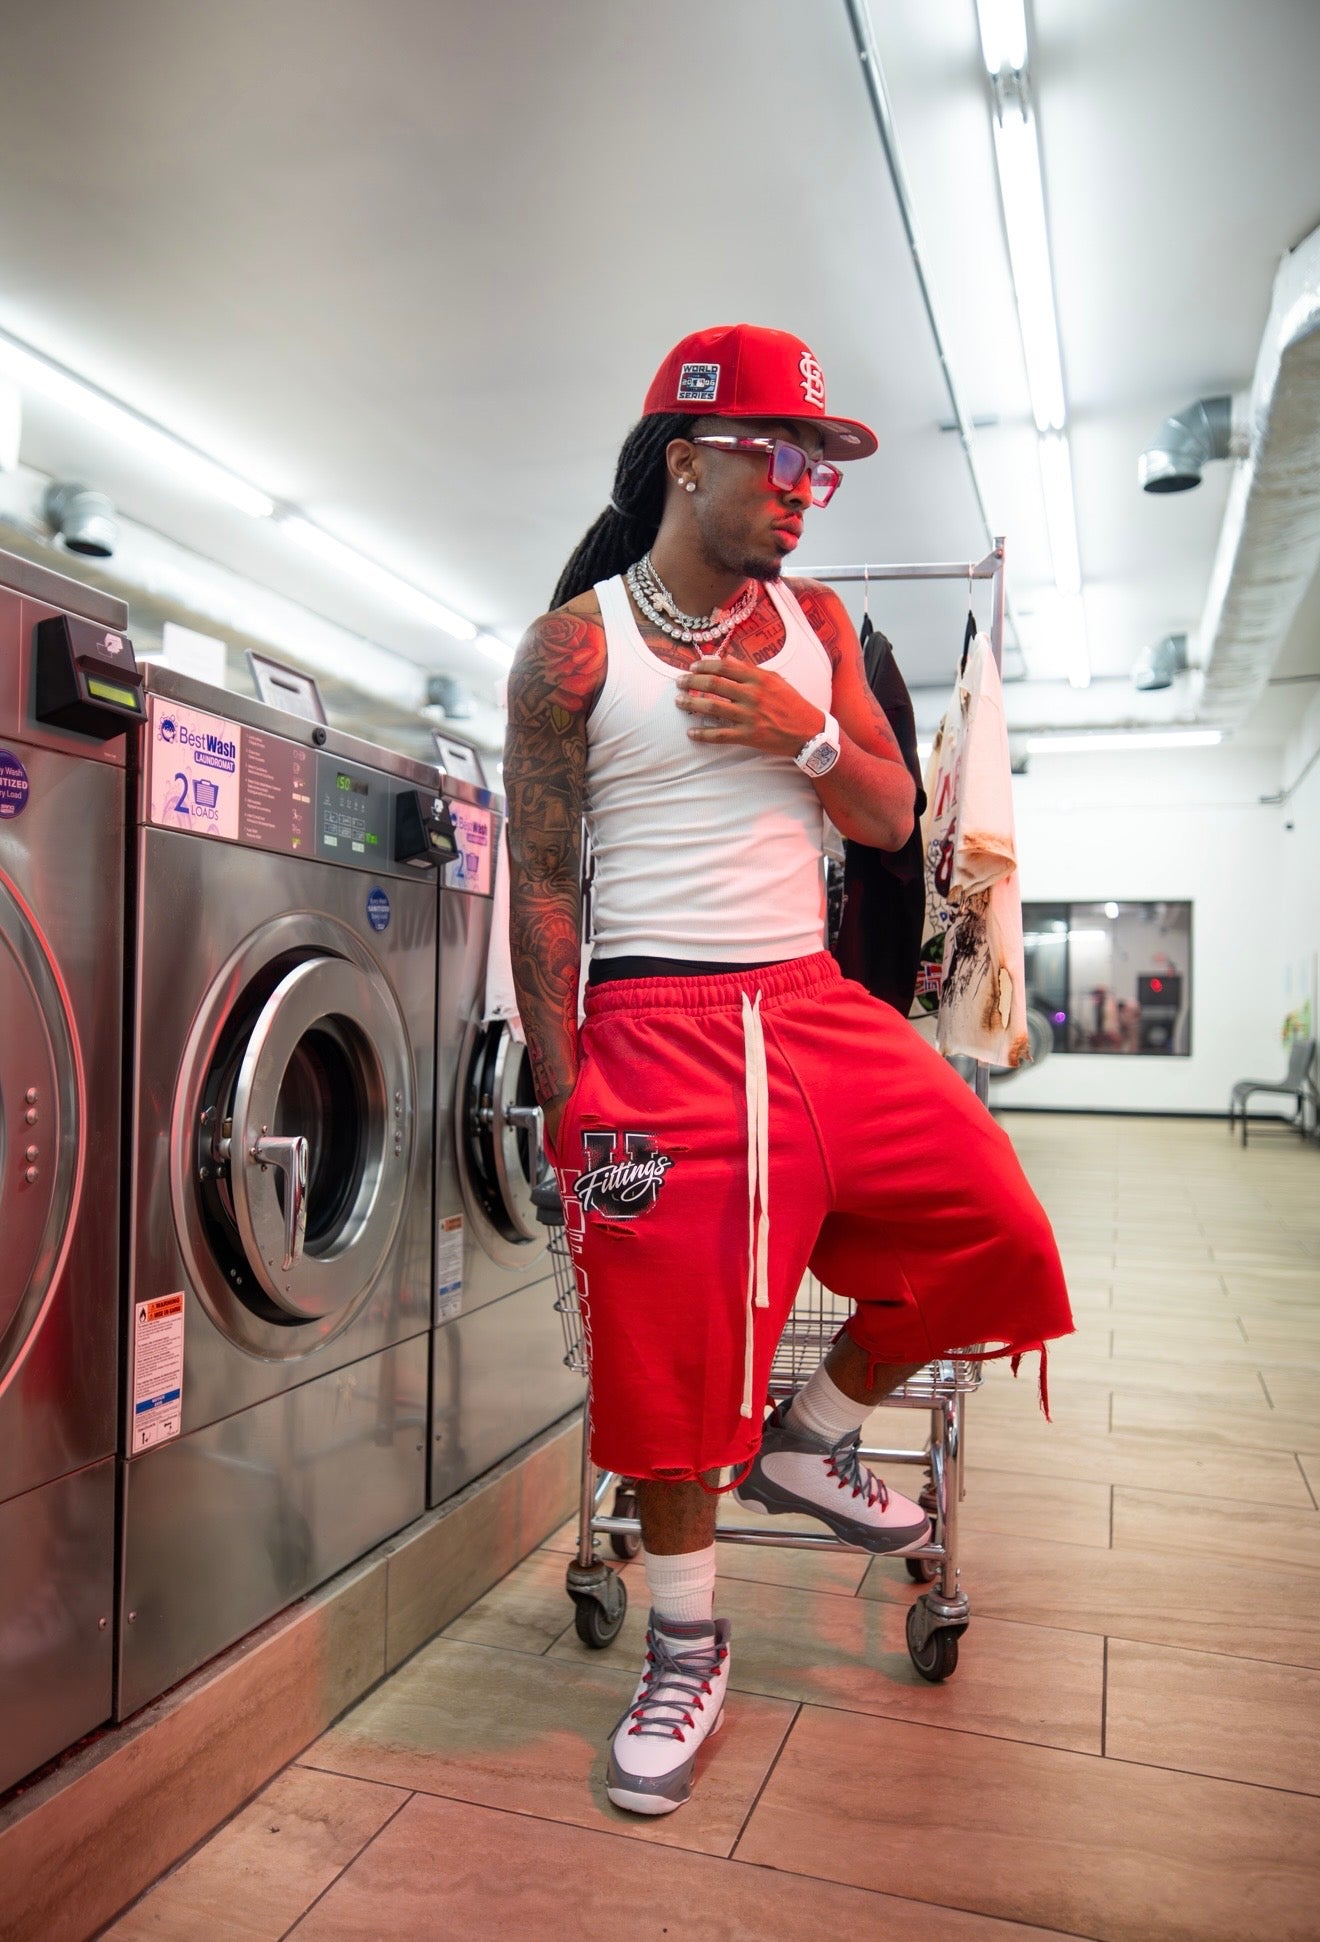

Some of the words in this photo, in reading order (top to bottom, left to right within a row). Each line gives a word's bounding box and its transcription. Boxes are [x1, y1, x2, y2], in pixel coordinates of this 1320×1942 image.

[683, 365, 718, 373] WORLD
[179, 726, 236, 759] BestWash
[195, 752, 235, 772] LAUNDROMAT
[7, 790, 22, 799] Load
[174, 772, 190, 814] 2
[191, 804, 219, 821] LOADS
[573, 1156, 672, 1212] Fittings
